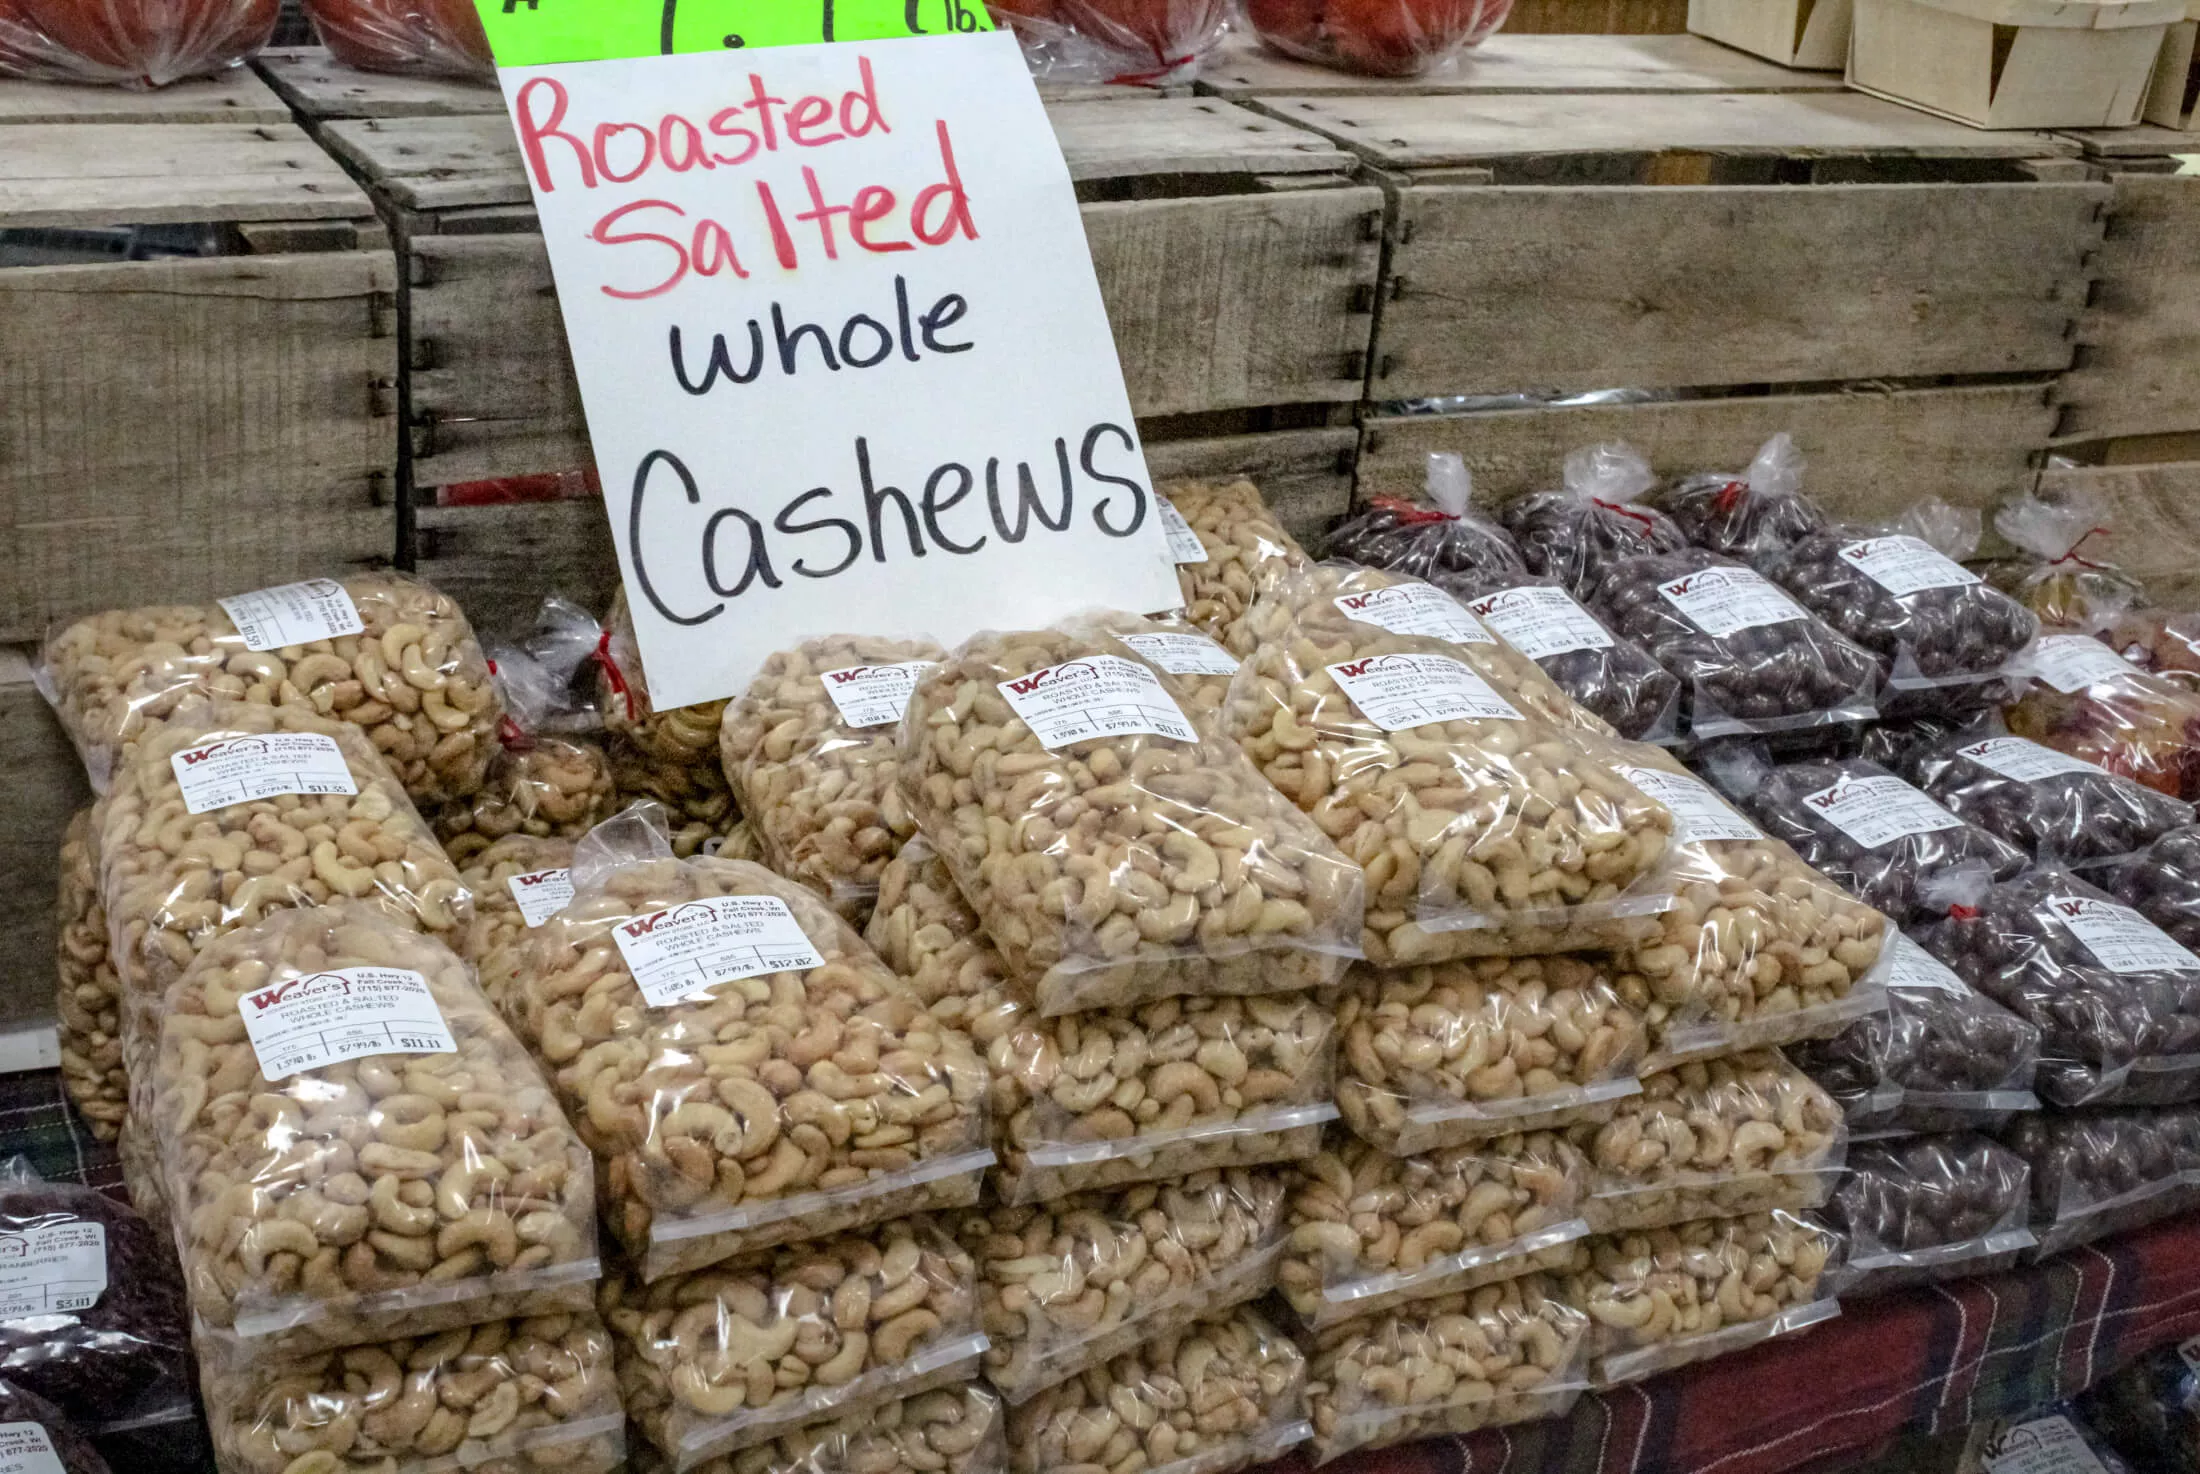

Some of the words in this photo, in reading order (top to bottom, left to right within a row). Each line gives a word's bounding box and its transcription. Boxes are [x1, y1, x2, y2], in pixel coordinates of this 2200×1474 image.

[516, 55, 891, 193] Roasted
[586, 119, 980, 300] Salted
[629, 422, 1149, 626] Cashews
[1006, 669, 1091, 695] Weaver's
[621, 910, 709, 938] Weaver's
[248, 980, 342, 1010] Weaver's
[400, 1038, 442, 1049] $11.11
